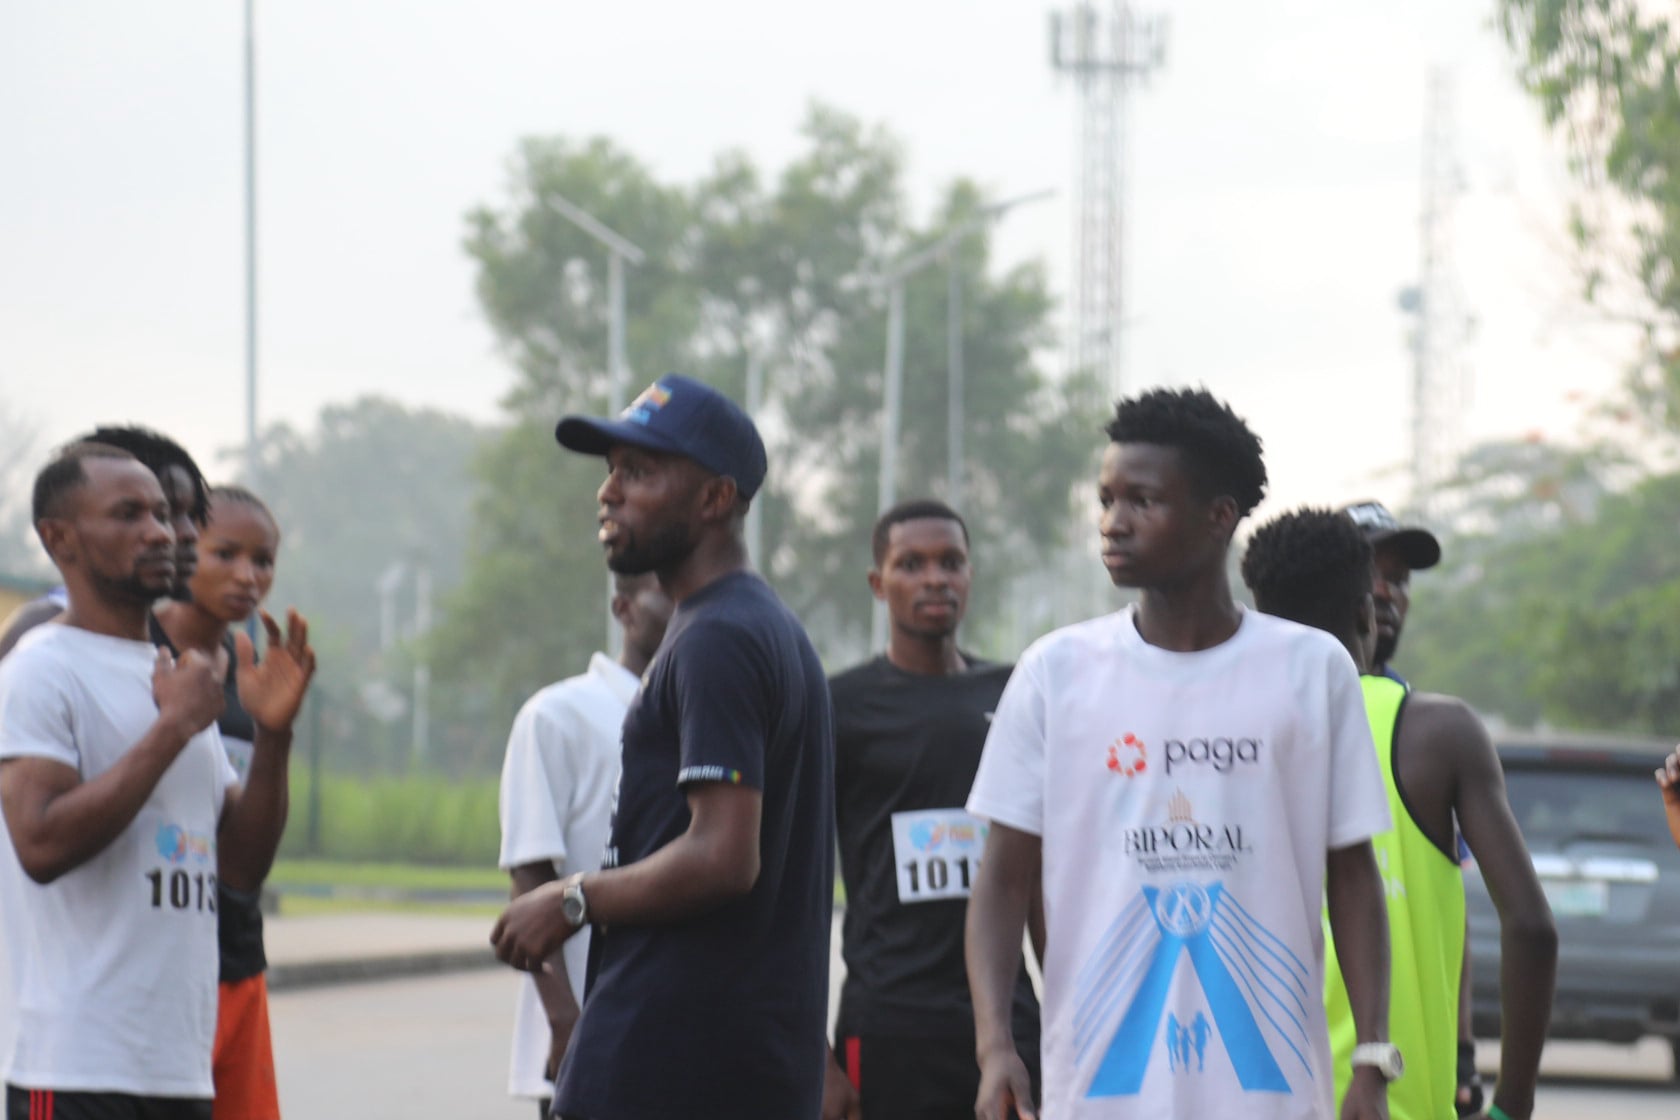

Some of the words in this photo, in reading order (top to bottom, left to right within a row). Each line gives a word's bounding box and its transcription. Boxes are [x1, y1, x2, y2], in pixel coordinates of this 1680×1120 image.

[1163, 737, 1259, 776] paga
[1124, 823, 1253, 856] BIPORAL
[904, 856, 985, 893] 101
